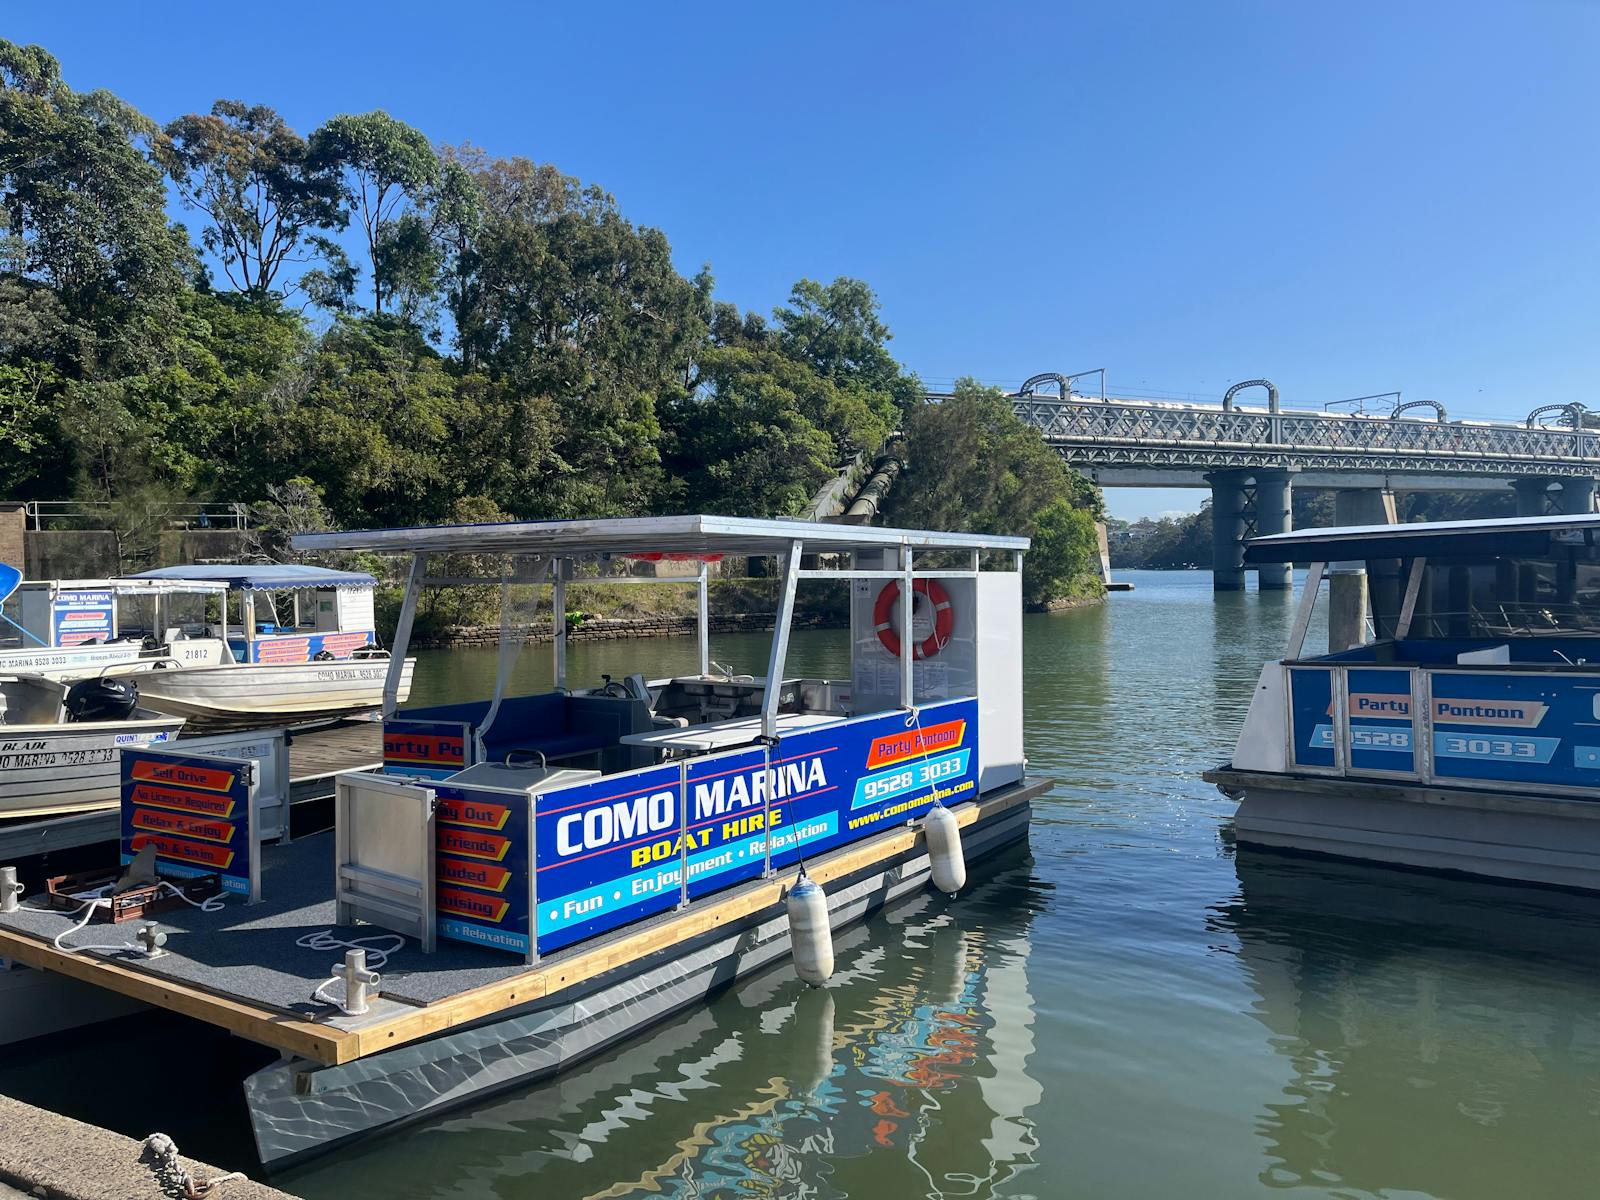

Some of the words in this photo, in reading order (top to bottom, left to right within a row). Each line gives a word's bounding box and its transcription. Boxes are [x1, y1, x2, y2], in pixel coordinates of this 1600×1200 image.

[79, 593, 110, 601] MARINA
[8, 657, 33, 668] MARINA
[35, 657, 50, 667] 9528
[185, 649, 208, 660] 21812
[1358, 697, 1409, 715] Party
[1437, 702, 1524, 720] Pontoon
[2, 740, 49, 751] BLADE
[878, 740, 912, 758] Party
[915, 729, 956, 748] Pontoon
[1321, 729, 1409, 748] 9528
[1446, 737, 1537, 758] 3033
[152, 767, 174, 779] Self
[177, 770, 208, 784] Drive
[864, 771, 913, 800] 9528
[919, 757, 961, 783] 3033
[137, 789, 149, 800] No
[184, 796, 226, 812] Required
[556, 791, 675, 857] COMO
[694, 757, 828, 820] MARINA
[143, 814, 173, 829] Relax
[189, 822, 222, 838] Enjoy
[464, 806, 496, 824] Out
[446, 834, 497, 854] Friends
[631, 827, 714, 869] BOAT
[722, 808, 782, 841] HIRE
[563, 895, 603, 919] Fun
[631, 850, 733, 896] Enjoyment
[749, 821, 828, 856] Relaxation
[462, 925, 525, 949] Relaxation
